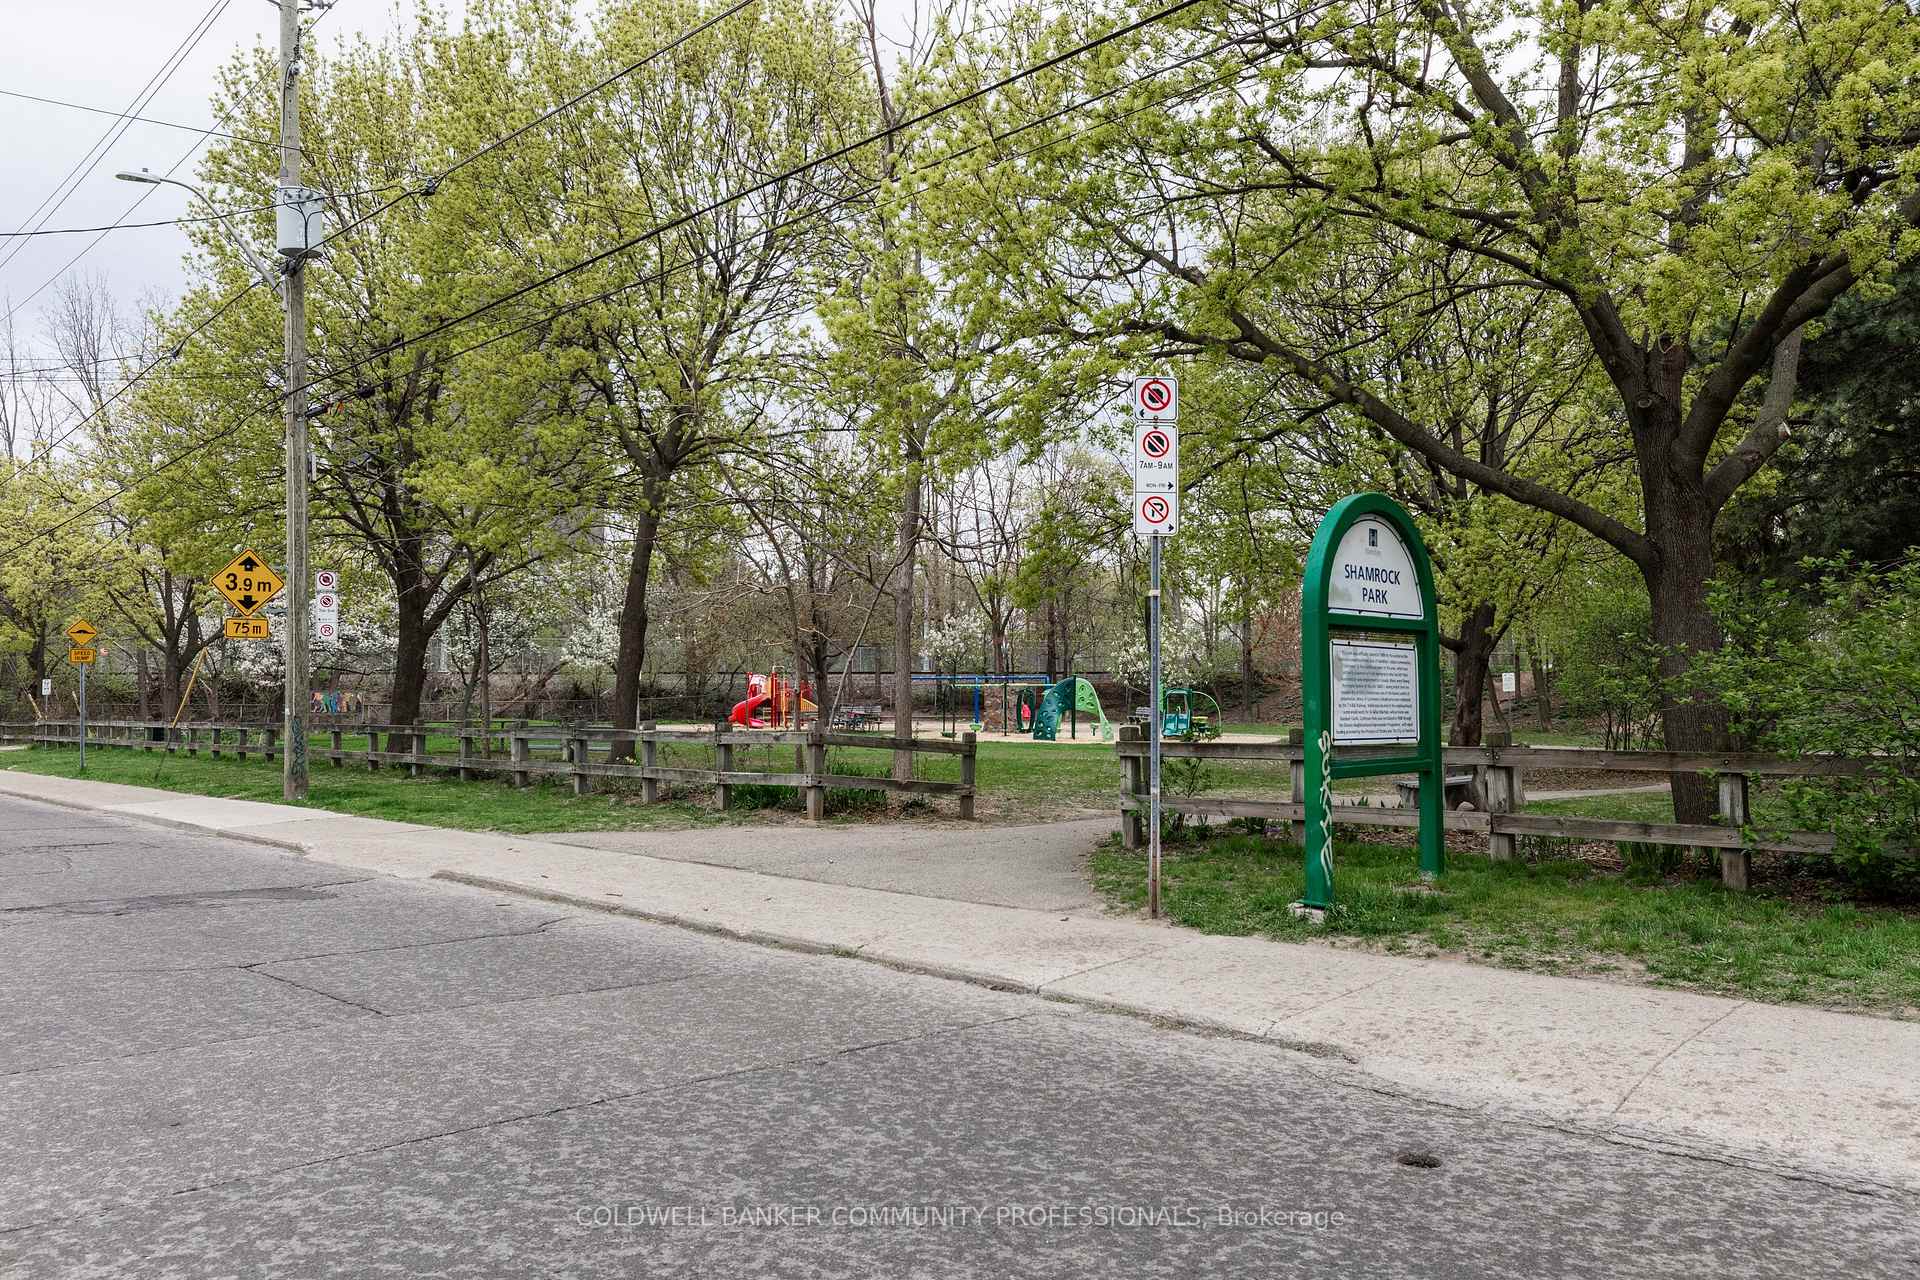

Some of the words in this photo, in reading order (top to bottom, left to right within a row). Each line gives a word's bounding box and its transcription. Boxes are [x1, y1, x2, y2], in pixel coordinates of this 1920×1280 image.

[225, 572, 253, 592] 3.9
[257, 581, 272, 592] m
[1344, 564, 1400, 585] SHAMROCK
[1362, 587, 1388, 604] PARK
[233, 622, 250, 634] 75
[252, 624, 262, 634] m
